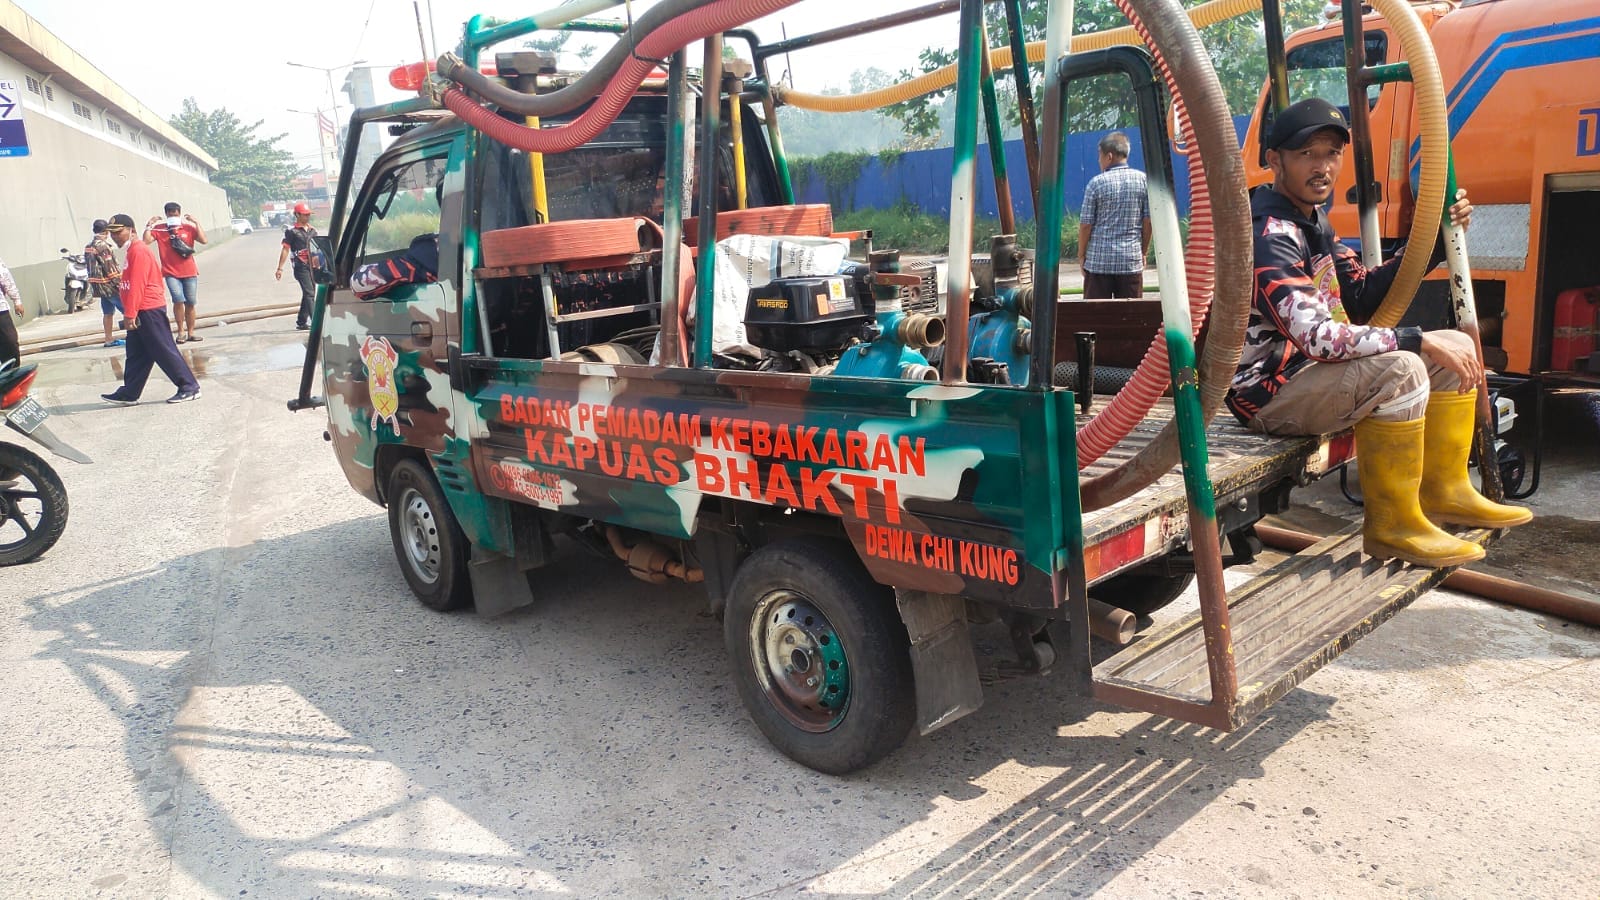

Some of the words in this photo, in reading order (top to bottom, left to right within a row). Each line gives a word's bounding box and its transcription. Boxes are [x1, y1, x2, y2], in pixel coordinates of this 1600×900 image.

[501, 395, 571, 428] BADAN
[578, 405, 701, 446] PEMADAM
[711, 419, 925, 476] KEBAKARAN
[525, 429, 680, 486] KAPUAS
[693, 452, 902, 525] BHAKTI
[865, 524, 917, 565] DEWA
[920, 534, 954, 572] CHI
[959, 541, 1018, 586] KUNG
